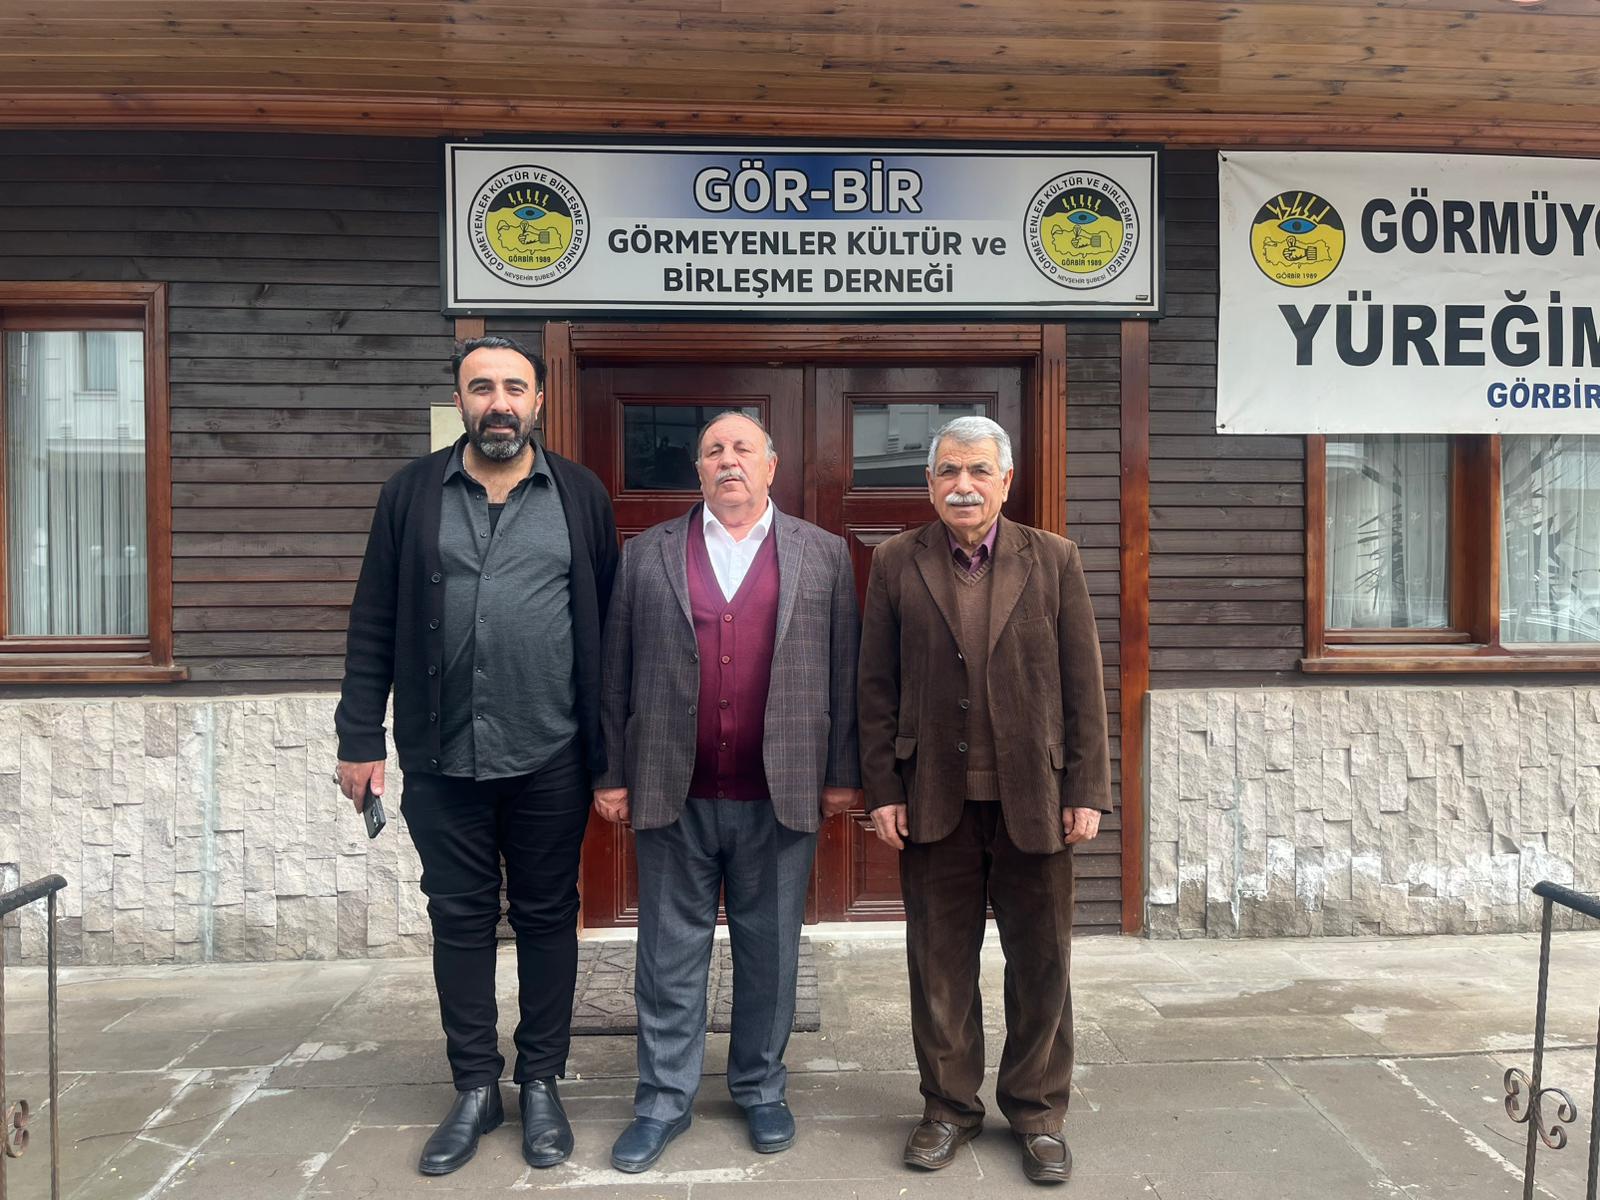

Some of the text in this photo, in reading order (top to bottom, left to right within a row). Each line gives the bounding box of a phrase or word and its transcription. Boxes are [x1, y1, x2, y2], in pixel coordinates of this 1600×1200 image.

[694, 159, 923, 214] GÖR-BİR
[474, 171, 584, 274] GÖRMEYENLER KÜLTÜR VE BİRLEŞME DERNEĞİ
[608, 224, 1007, 256] GÖRMEYENLER KÜLTÜR ve
[1029, 176, 1134, 277] GÖRMEYENLER KÜLTÜR VE BİRLEŞME DERNEĞİ
[1361, 187, 1600, 257] GÖRMÜY
[508, 254, 534, 263] GÖRBİR
[663, 263, 953, 298] BİRLEŞME DERNEĞİ
[1487, 377, 1600, 408] GÖRBİR
